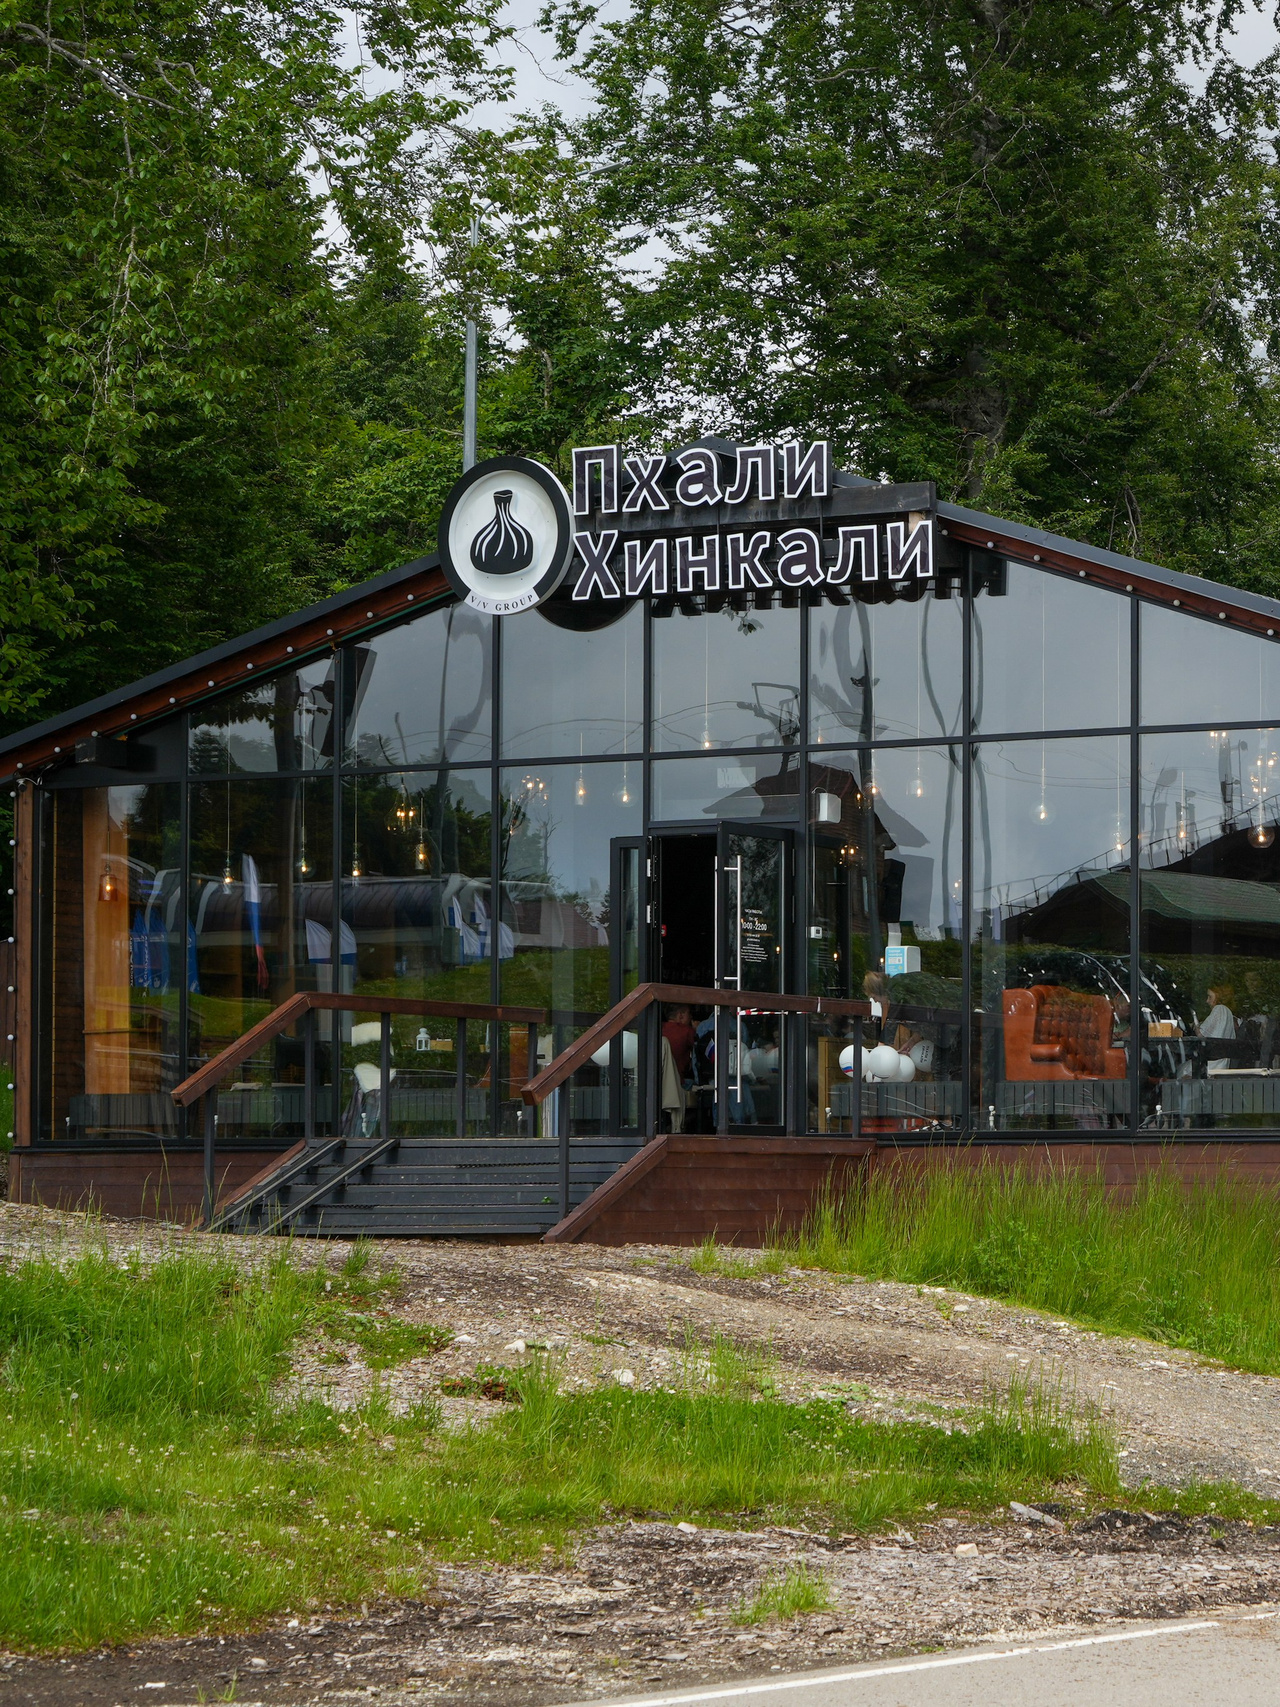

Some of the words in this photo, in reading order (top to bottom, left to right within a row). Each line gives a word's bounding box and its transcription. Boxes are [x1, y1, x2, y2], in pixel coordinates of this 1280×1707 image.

[571, 440, 832, 516] Пхали
[572, 519, 936, 601] Хинкали
[470, 595, 489, 609] V/V
[495, 594, 533, 611] GROUP
